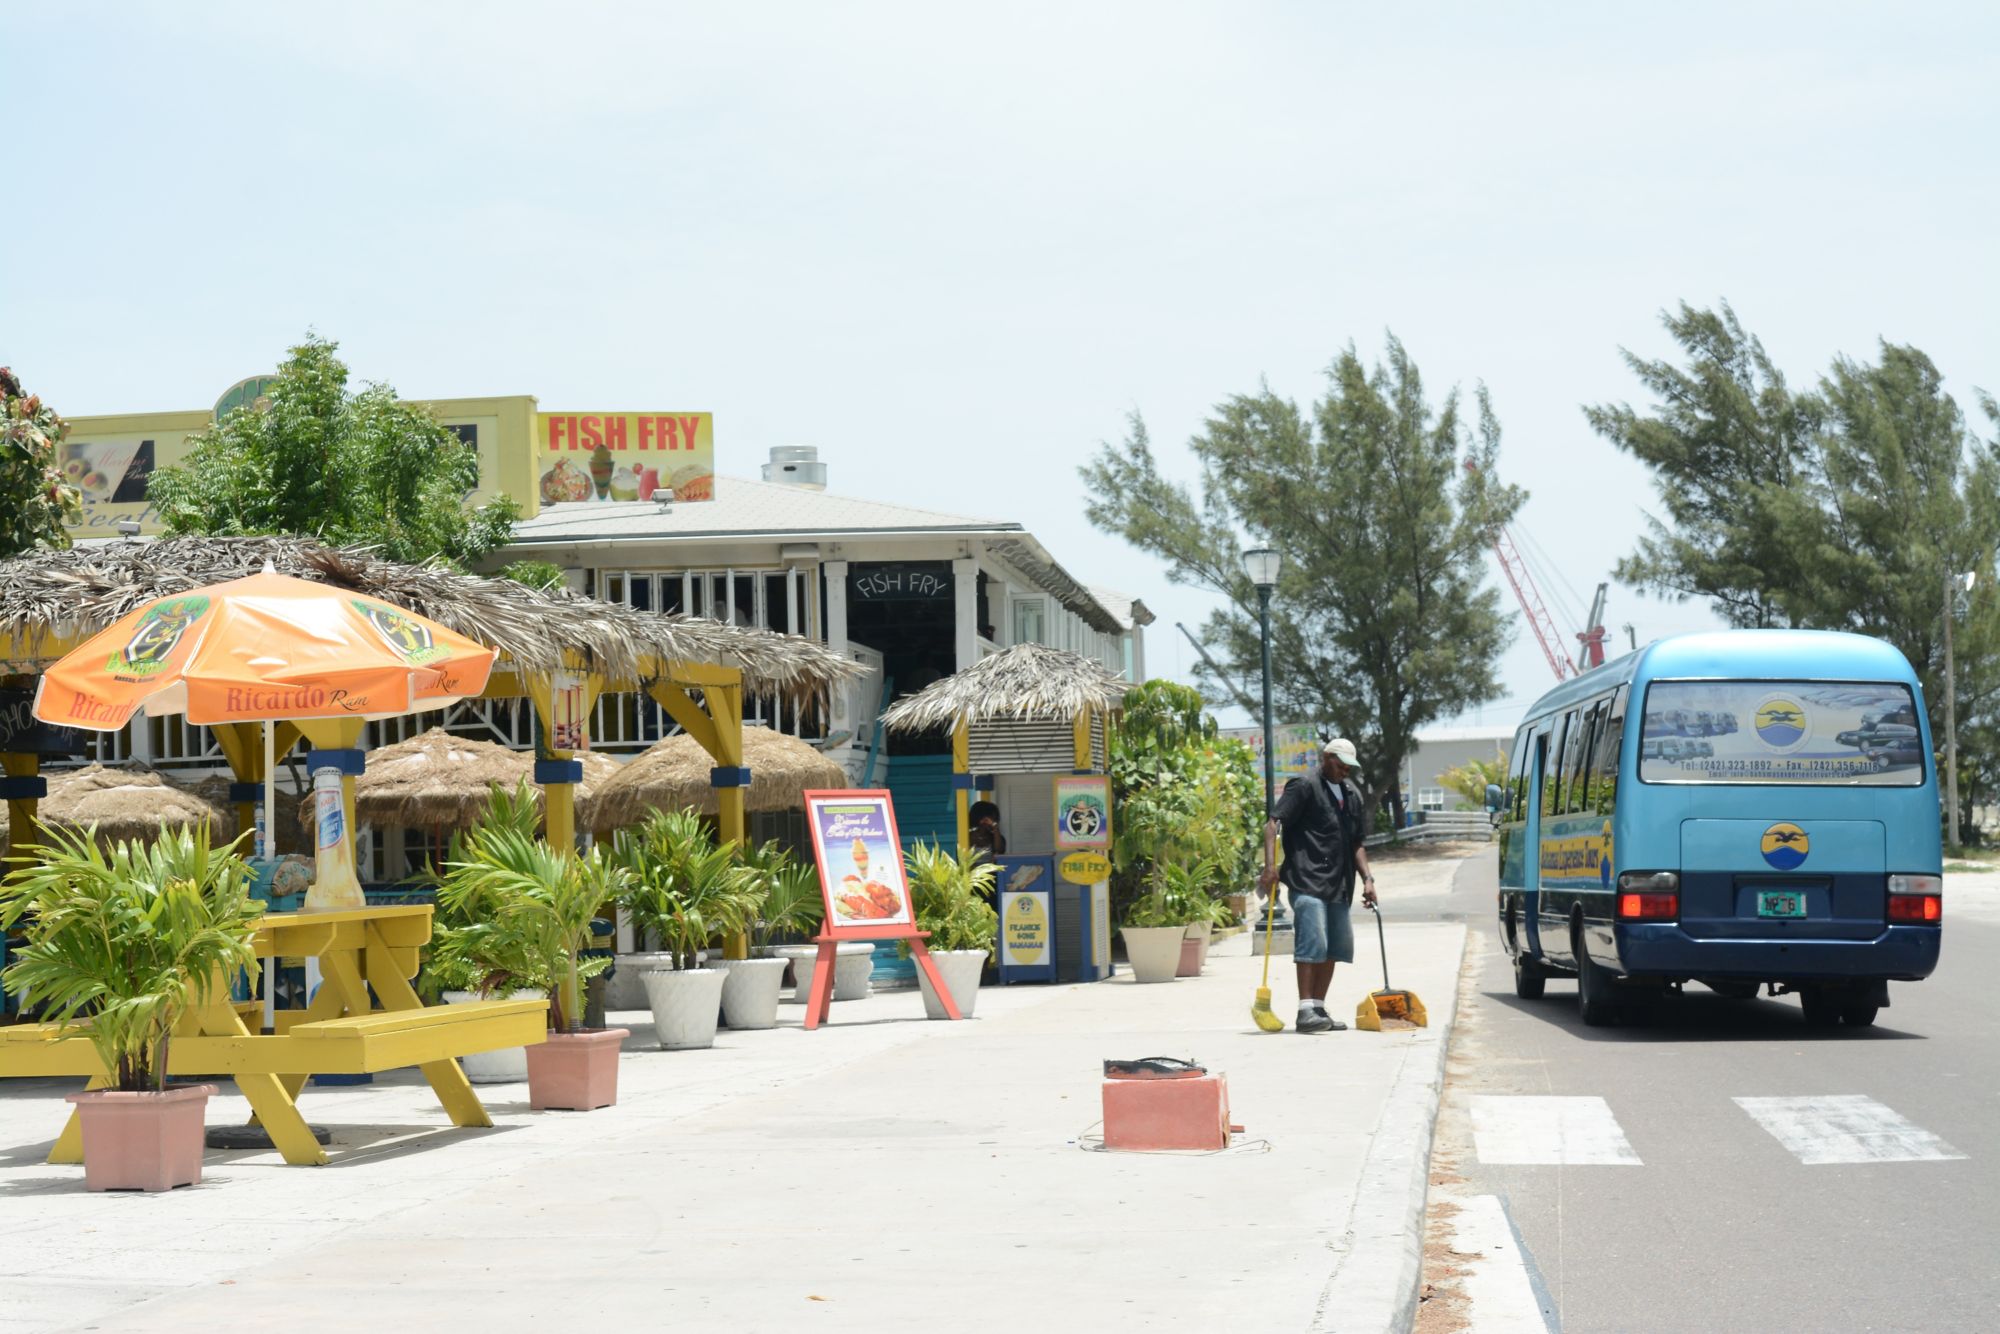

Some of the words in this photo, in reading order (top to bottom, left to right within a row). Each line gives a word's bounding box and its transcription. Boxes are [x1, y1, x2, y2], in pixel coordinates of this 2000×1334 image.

[549, 416, 627, 450] FISH
[638, 416, 699, 450] FRY
[856, 573, 901, 598] FISH
[909, 573, 947, 596] FRY
[67, 691, 135, 722] Ricard
[226, 685, 325, 713] Ricardo
[328, 689, 369, 712] Rum
[1728, 760, 1772, 771] 323-1892
[1786, 760, 1805, 771] Fax:
[1062, 862, 1085, 873] FISH
[1087, 862, 1107, 873] FRY
